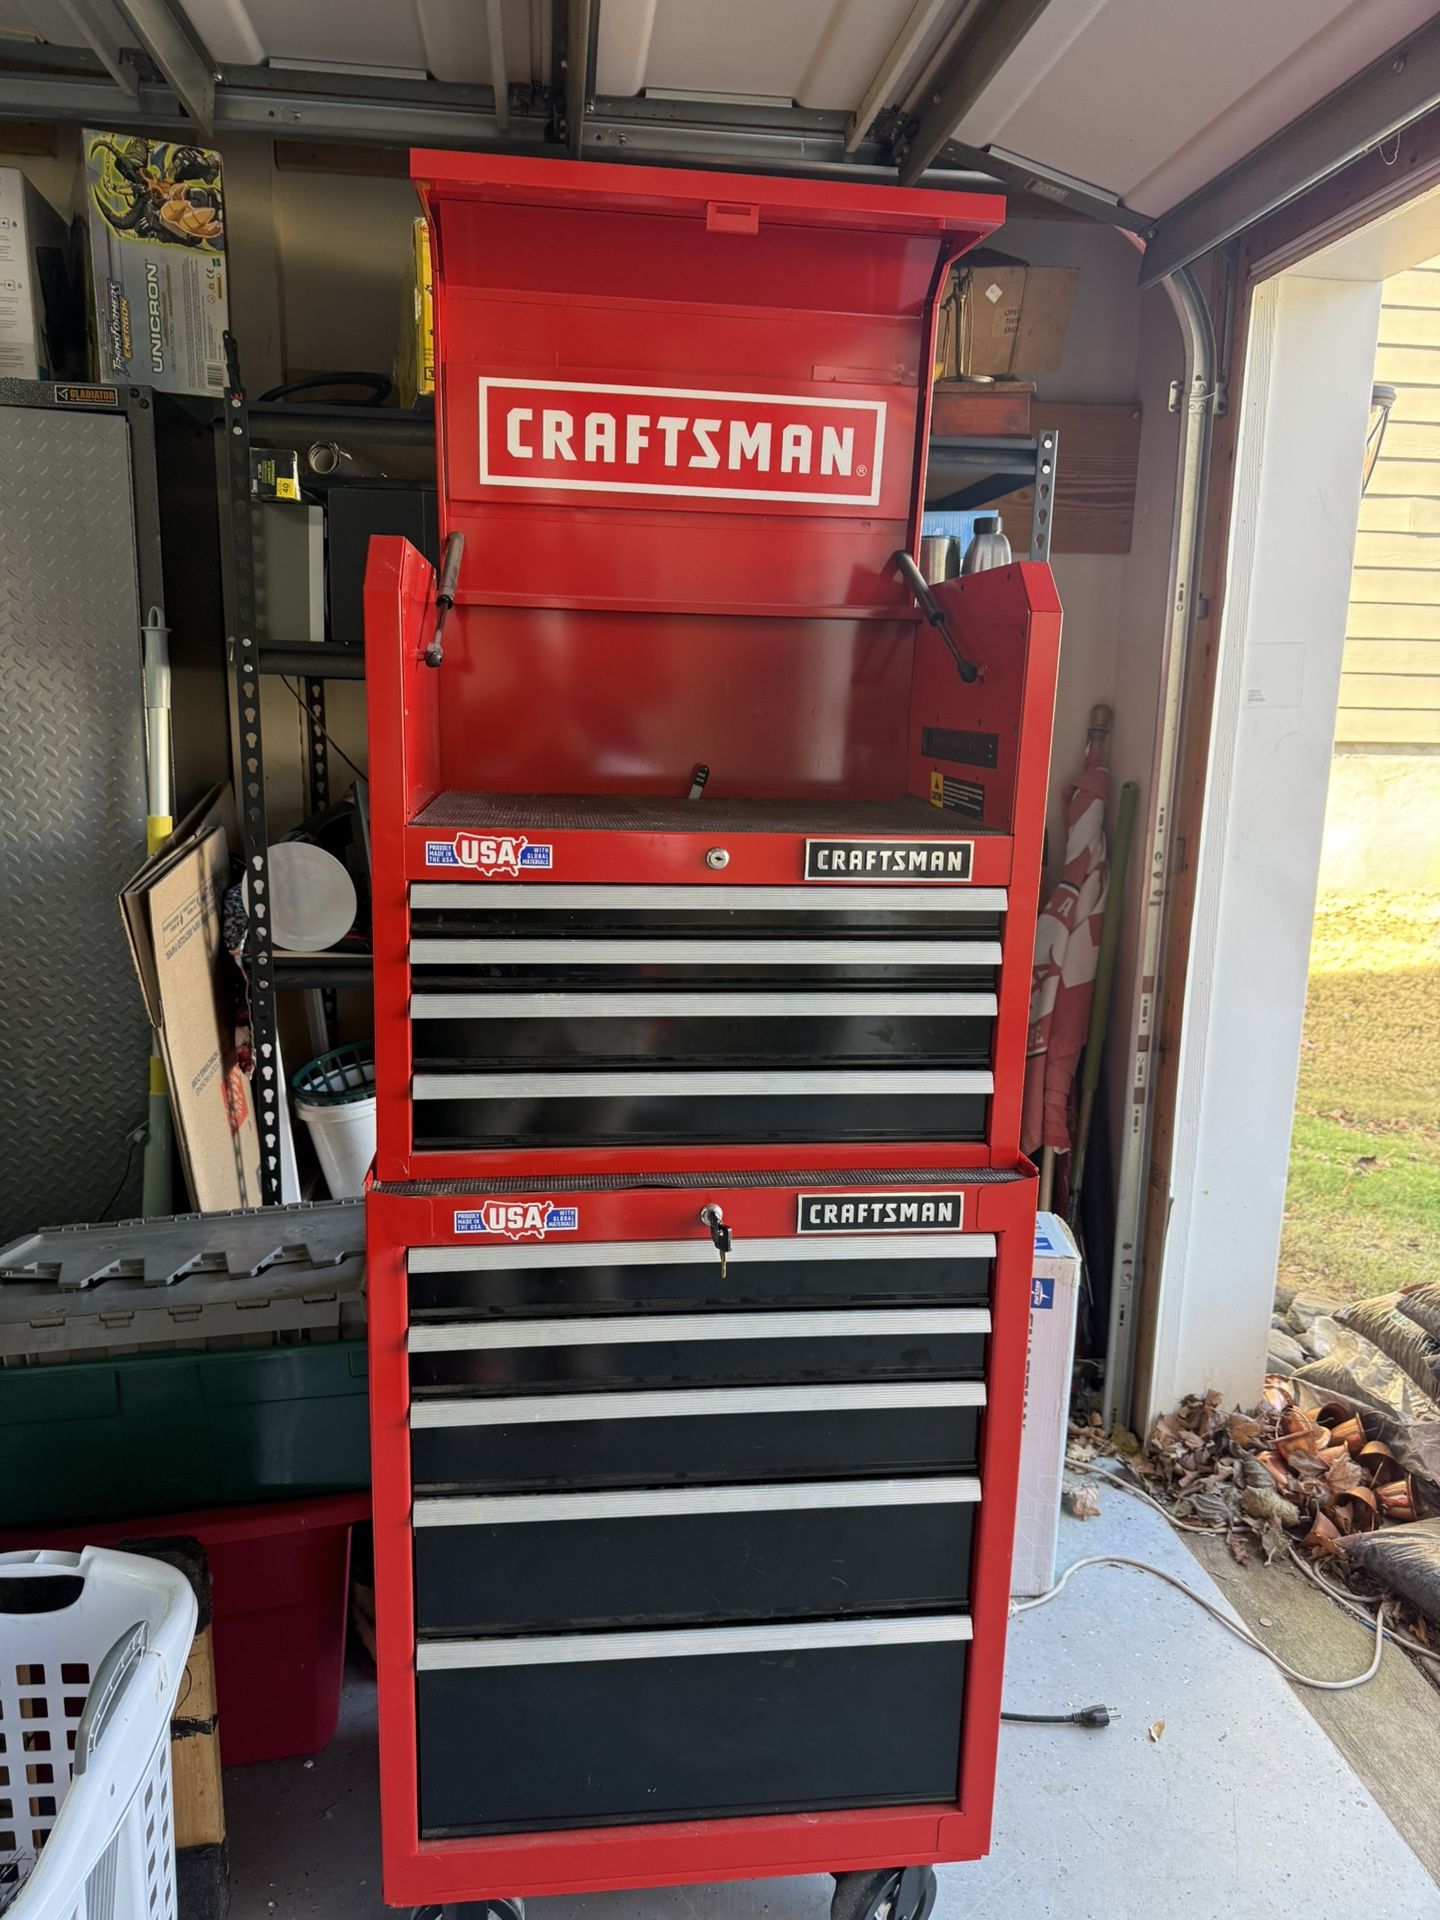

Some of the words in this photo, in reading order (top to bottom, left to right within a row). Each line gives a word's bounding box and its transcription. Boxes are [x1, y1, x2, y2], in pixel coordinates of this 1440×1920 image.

[120, 297, 132, 360] ENERGON
[146, 263, 163, 373] UNICRON
[69, 388, 115, 400] GLADIATOR
[506, 407, 854, 477] CRAFTSMAN
[282, 483, 289, 493] 40
[461, 840, 517, 864] USA
[817, 849, 963, 872] CRAFTSMAN
[489, 1207, 543, 1229] USA
[809, 1202, 953, 1224] CRAFTSMAN
